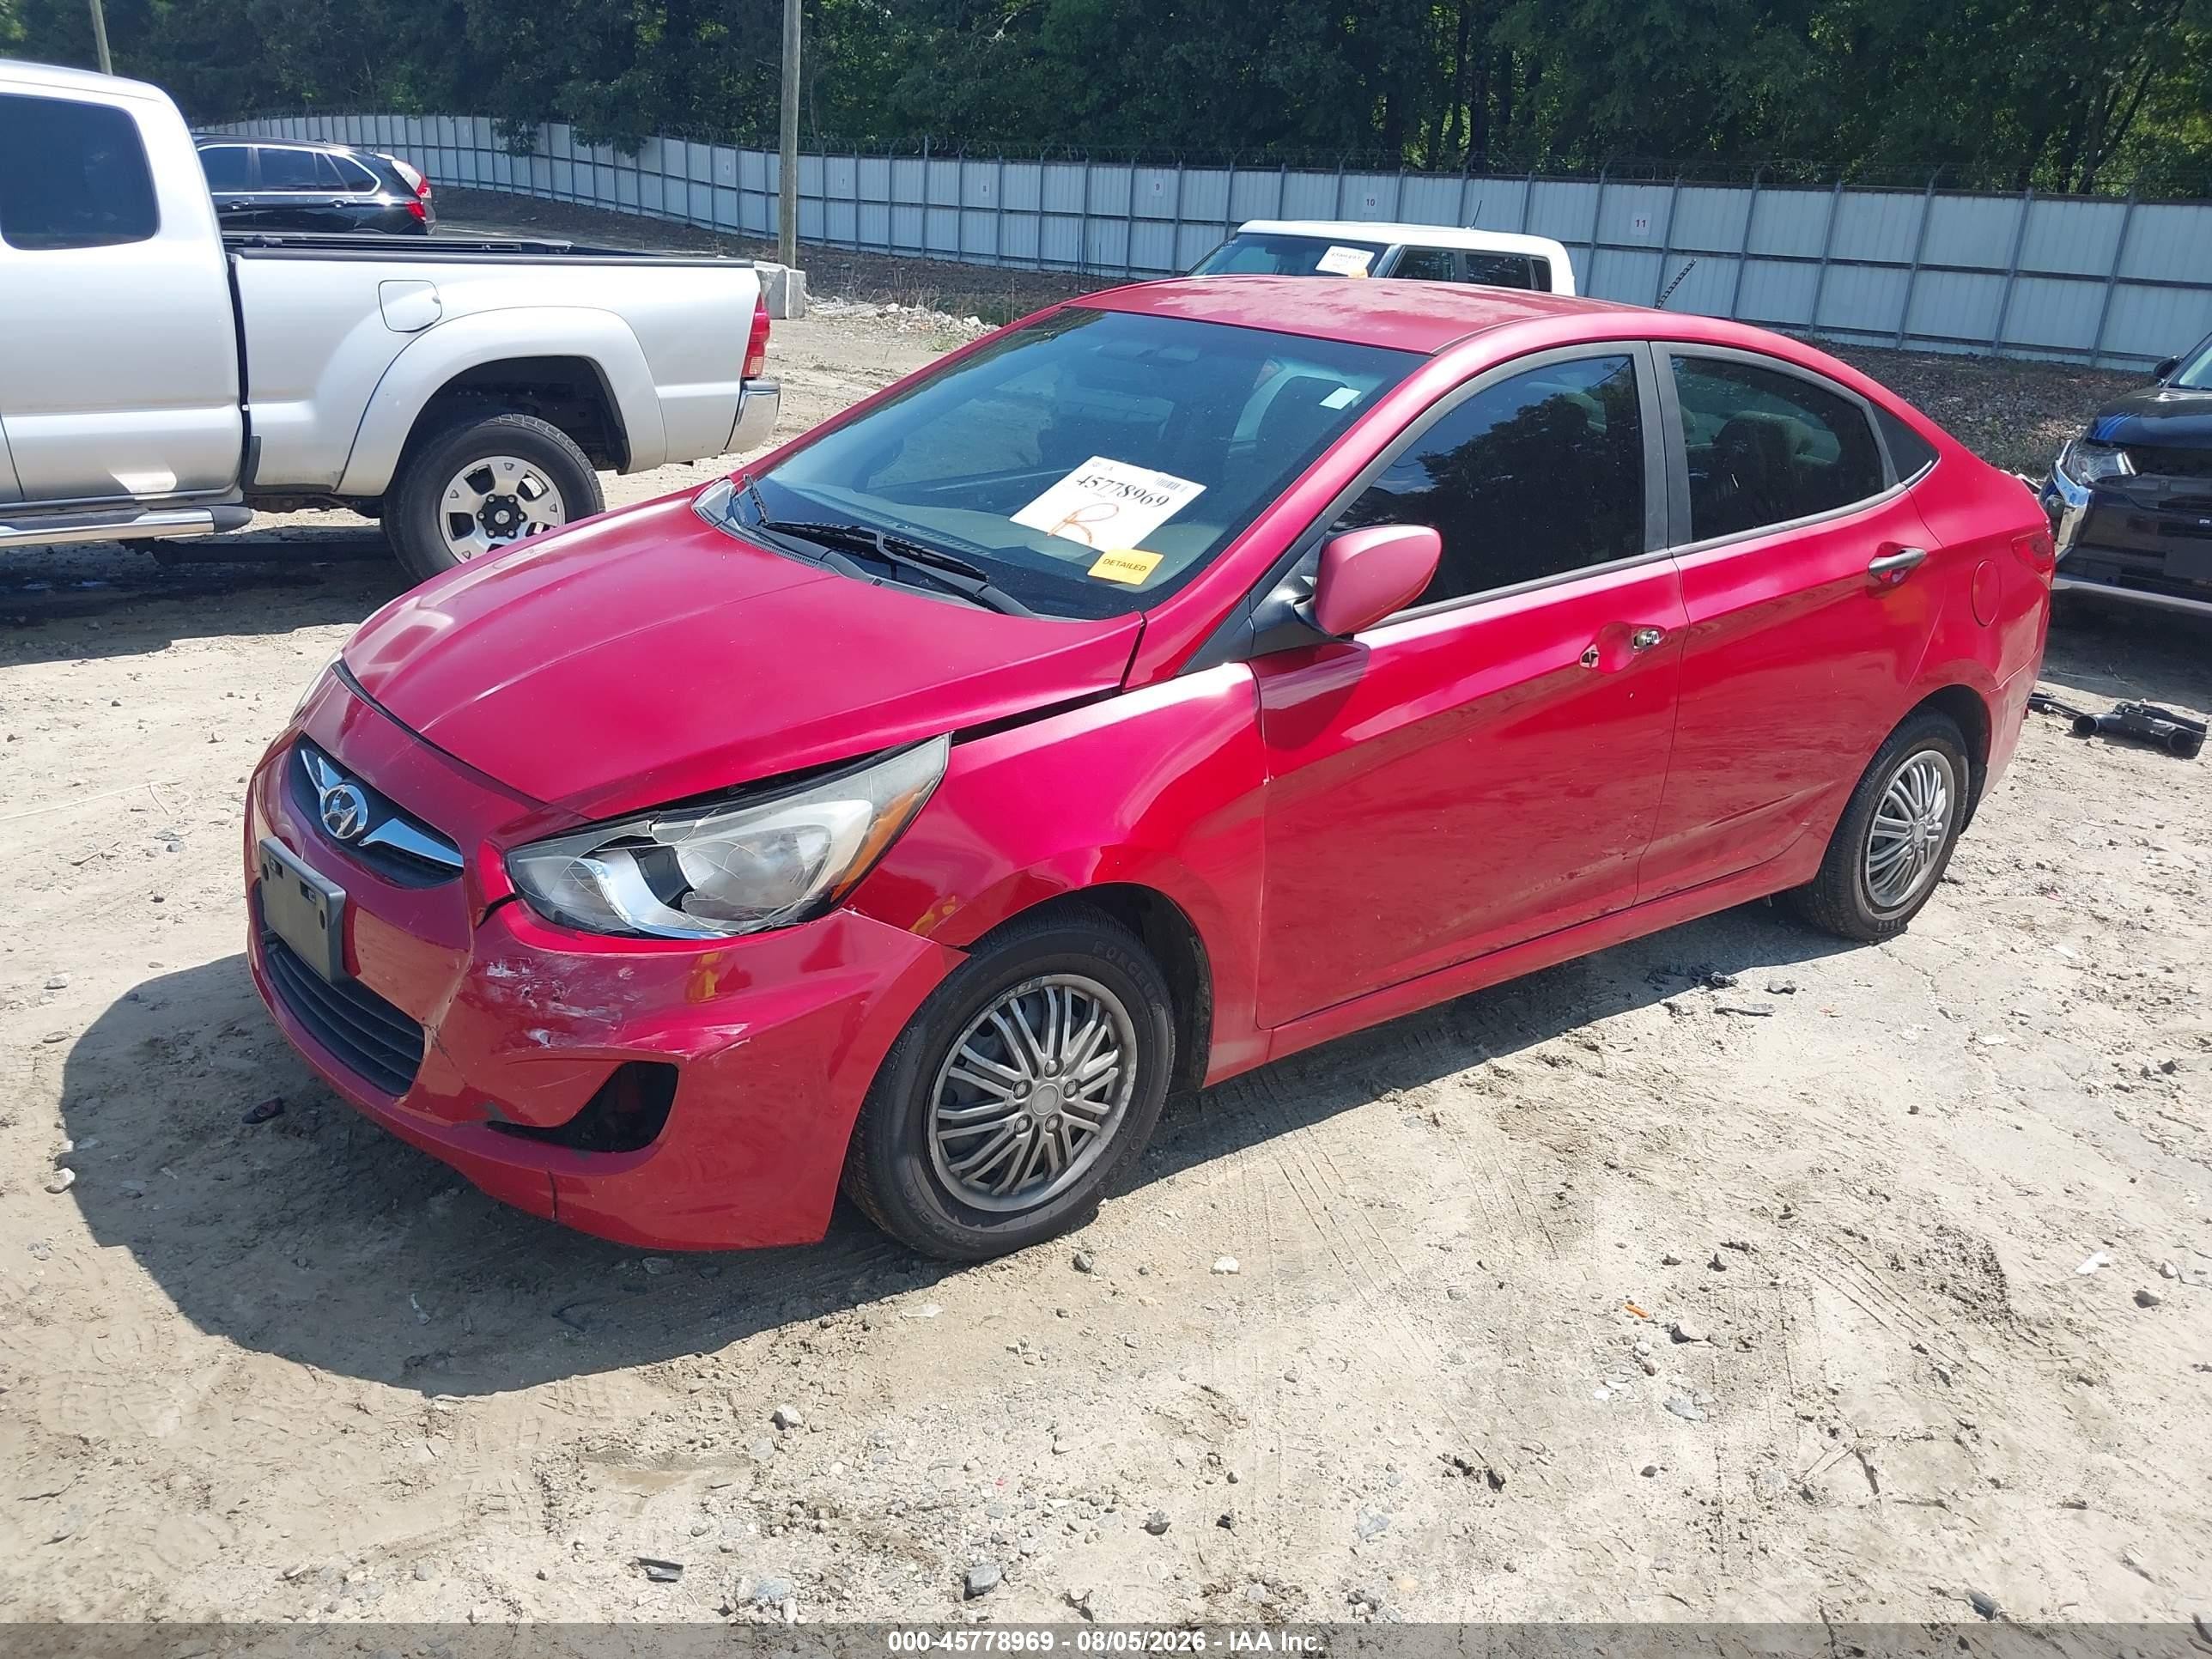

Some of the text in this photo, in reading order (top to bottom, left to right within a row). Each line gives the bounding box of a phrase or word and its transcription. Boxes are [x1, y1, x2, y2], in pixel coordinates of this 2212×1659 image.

[1366, 198, 1376, 207] 10
[1635, 219, 1646, 228] 11
[1075, 473, 1170, 508] 45778969
[1102, 557, 1147, 572] DETAILED
